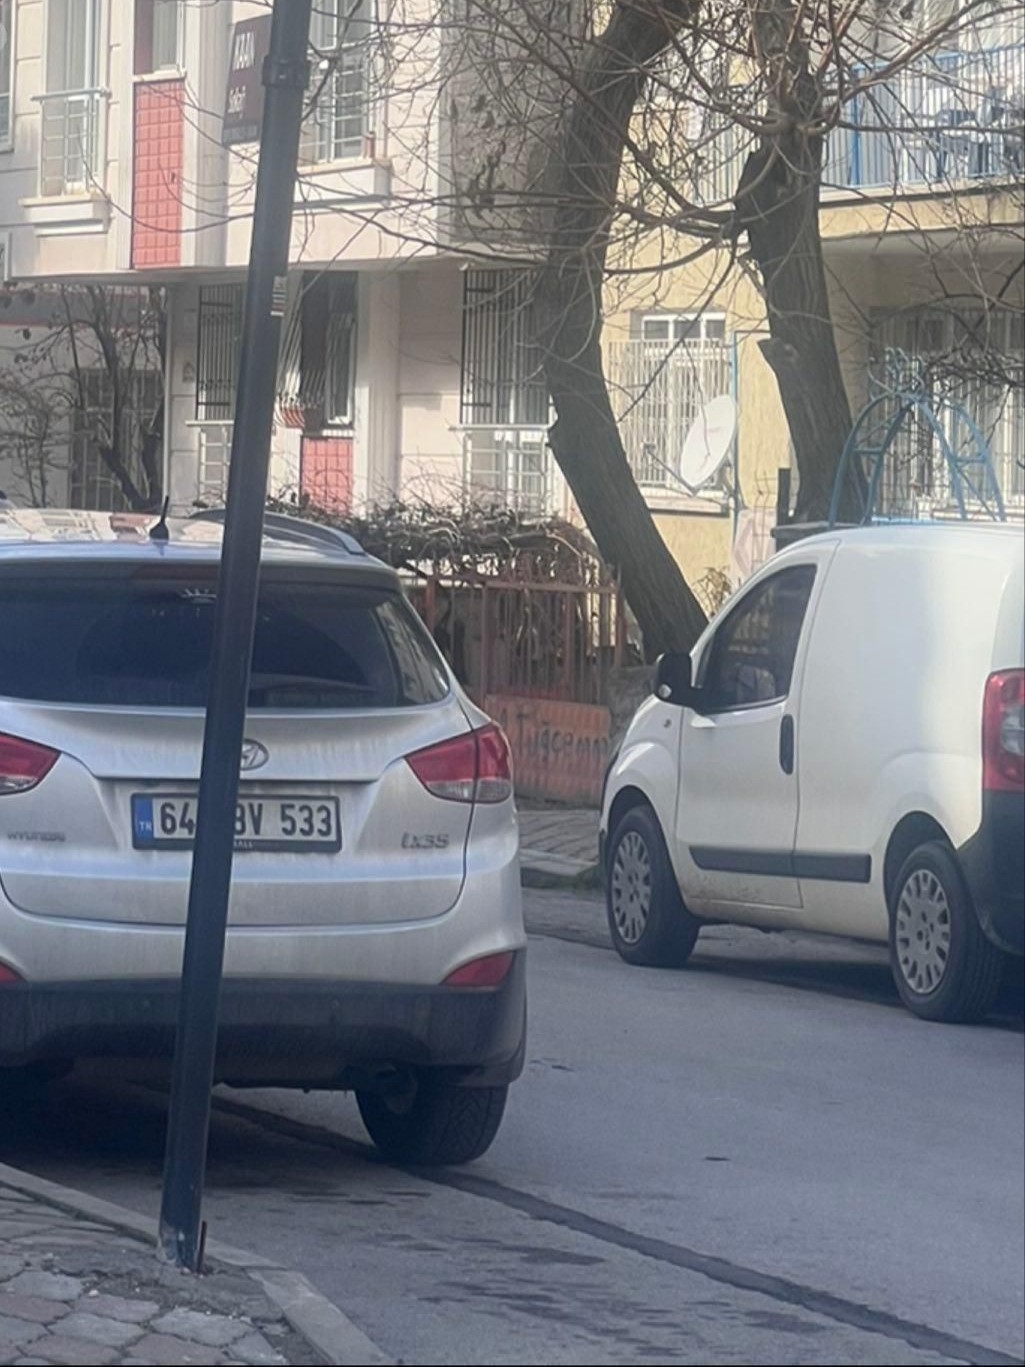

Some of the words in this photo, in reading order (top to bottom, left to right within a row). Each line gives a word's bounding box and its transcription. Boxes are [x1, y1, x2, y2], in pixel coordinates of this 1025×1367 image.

[160, 802, 195, 835] 64
[233, 803, 263, 835] BV
[280, 804, 331, 836] 533
